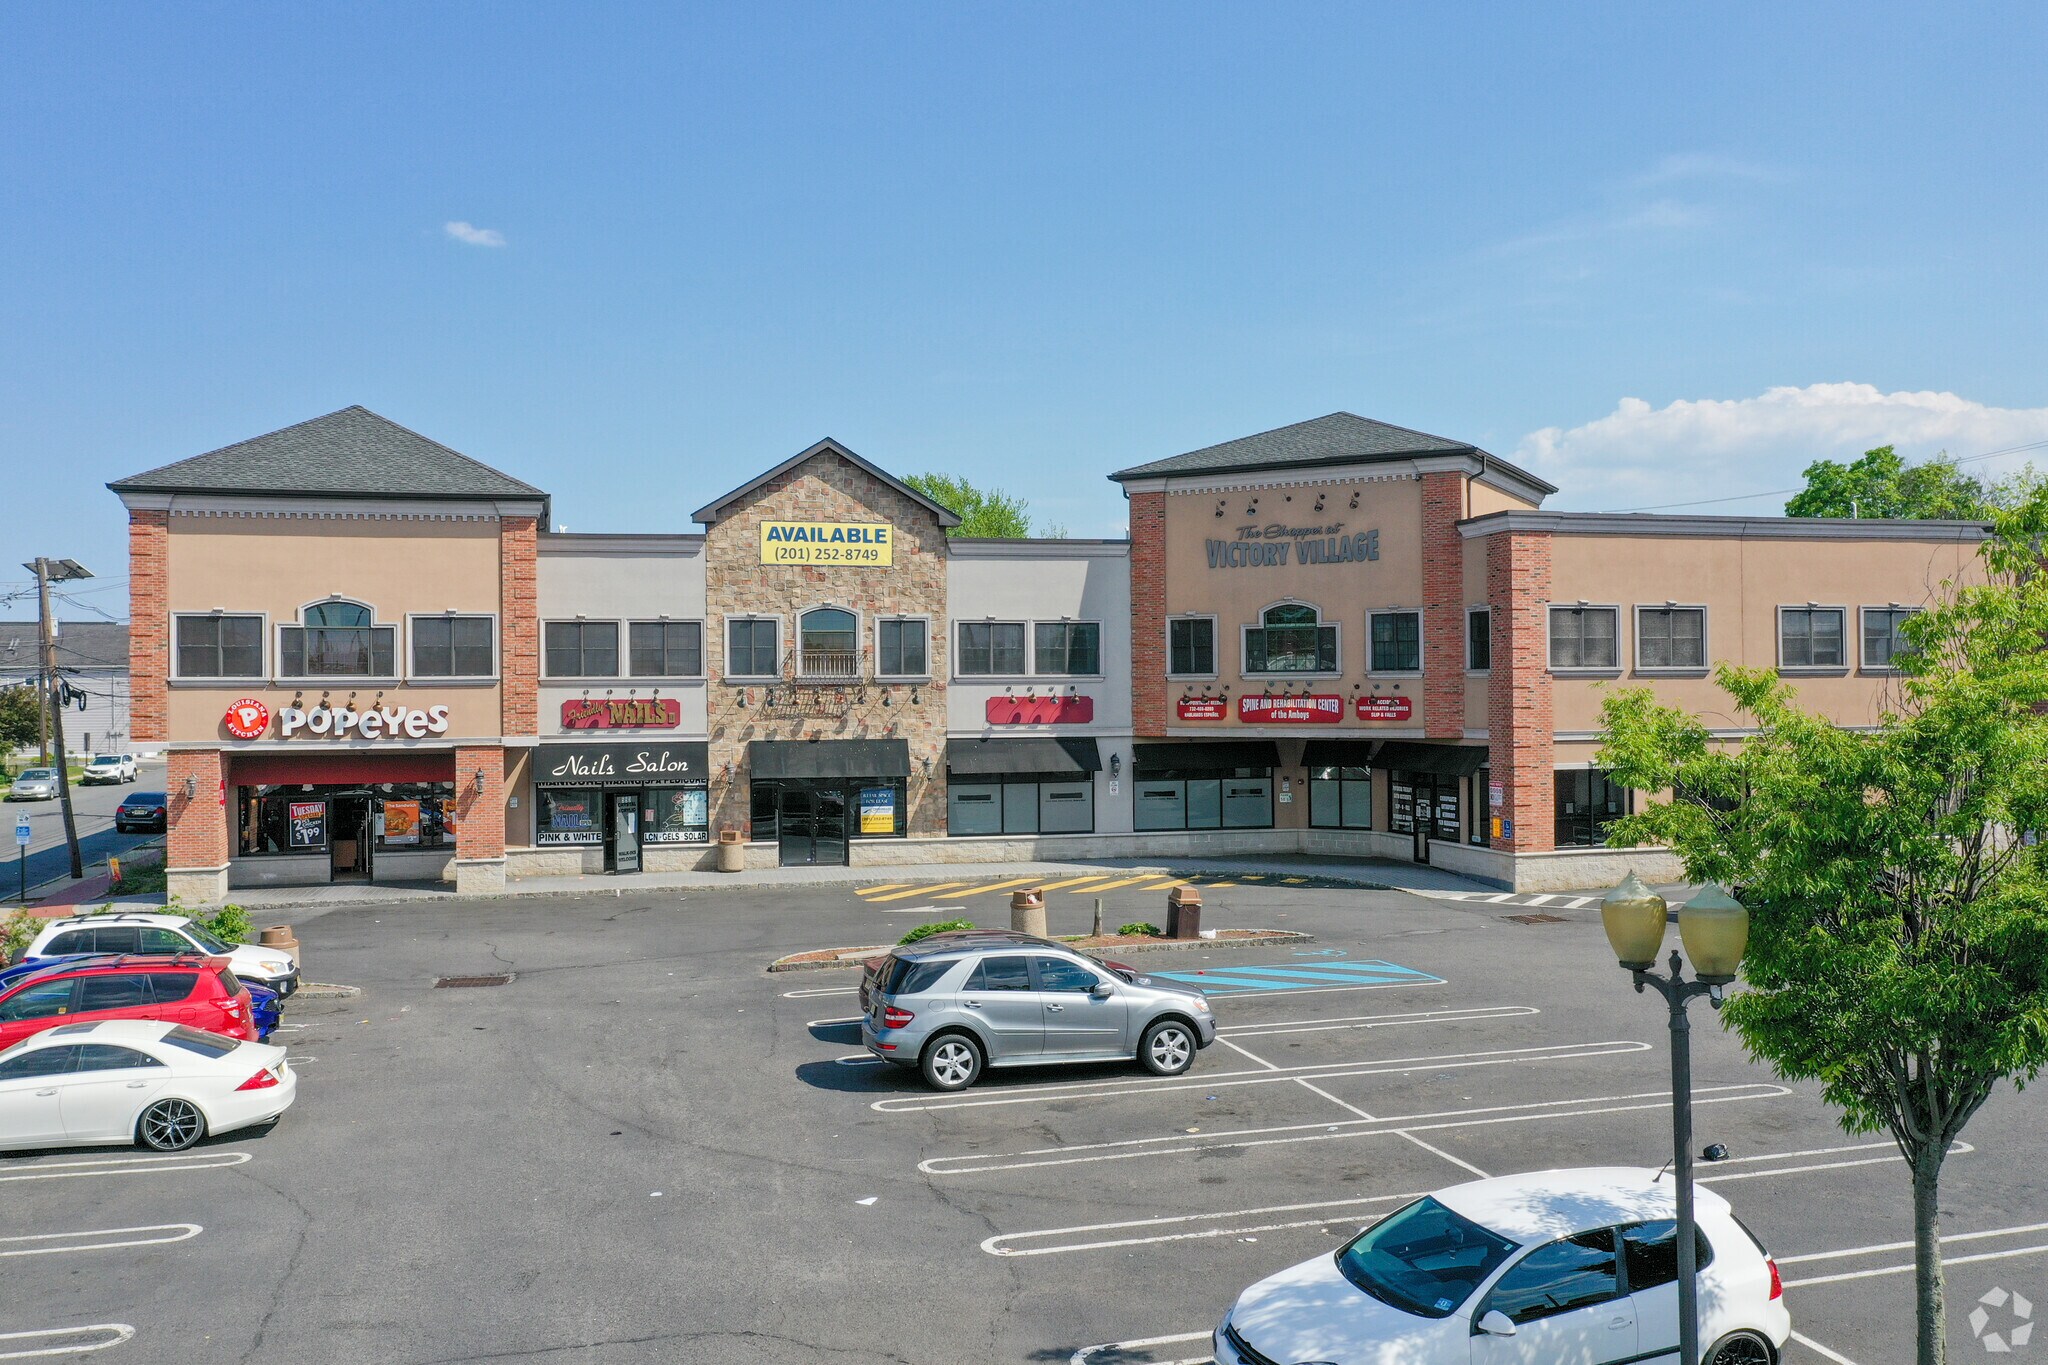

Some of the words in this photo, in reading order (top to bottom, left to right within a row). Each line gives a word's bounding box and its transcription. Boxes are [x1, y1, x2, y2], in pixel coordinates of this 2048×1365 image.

[766, 526, 887, 544] AVAILABLE
[1236, 525, 1262, 540] The
[1325, 522, 1345, 535] at
[775, 547, 810, 562] (201)
[815, 548, 878, 561] 252-8749
[1205, 538, 1290, 568] VICTORY
[1295, 529, 1379, 565] VILLAGE
[227, 699, 267, 717] LOUISIANA
[567, 702, 604, 723] Friendly
[609, 703, 667, 724] NAILS
[1242, 698, 1259, 712] SPINE
[1259, 698, 1272, 709] AND
[1272, 698, 1317, 709] REHABILITATION
[1317, 698, 1339, 714] CENTER
[237, 707, 259, 728] P
[279, 704, 449, 739] POPEYES
[1270, 710, 1277, 718] of
[1278, 710, 1287, 718] the
[1287, 710, 1310, 720] Amboys
[227, 723, 265, 738] KITCHEN
[552, 754, 615, 776] Nails
[626, 751, 689, 772] Salon
[291, 803, 323, 817] TUESDAY
[293, 819, 303, 831] 2
[539, 833, 560, 841] PINK
[564, 833, 570, 841] &
[572, 833, 602, 841] WHITE
[645, 833, 658, 841] LCN
[662, 833, 680, 841] GELS
[683, 832, 707, 840] SOLAR
